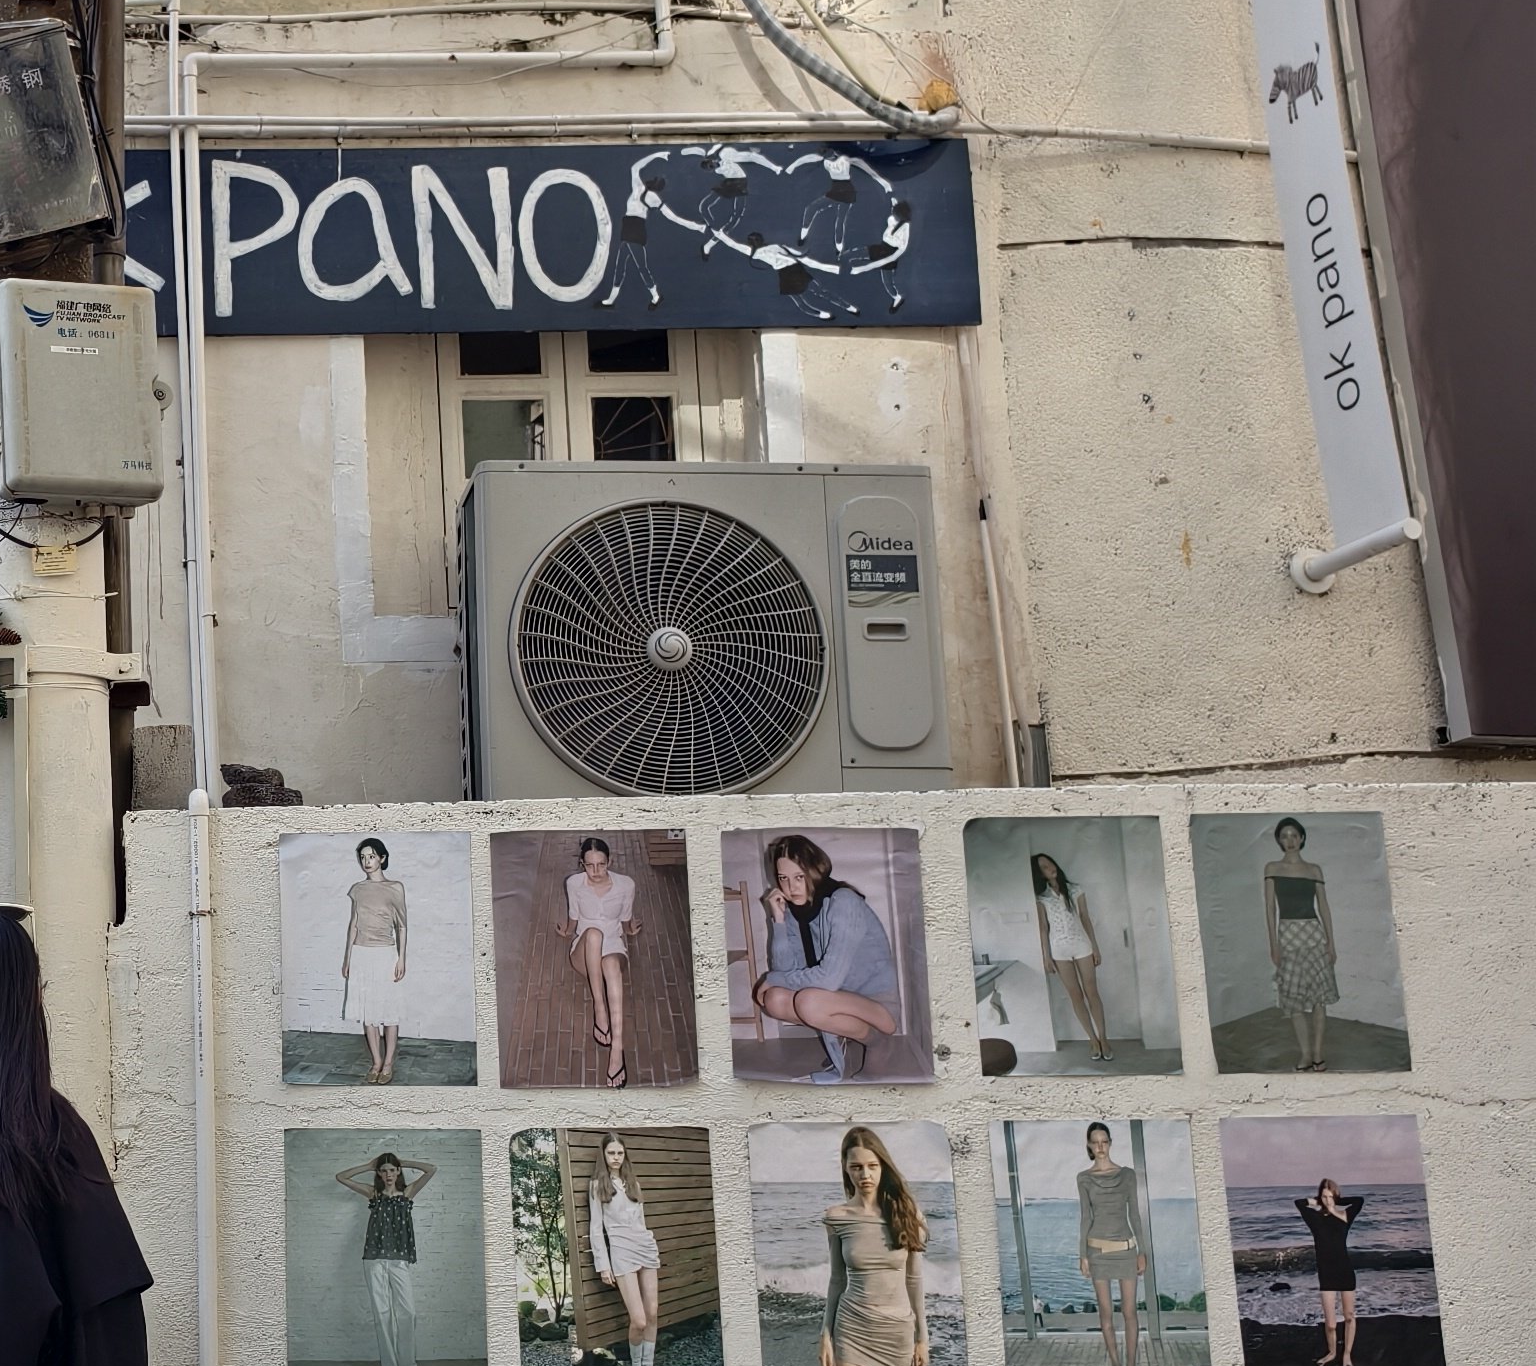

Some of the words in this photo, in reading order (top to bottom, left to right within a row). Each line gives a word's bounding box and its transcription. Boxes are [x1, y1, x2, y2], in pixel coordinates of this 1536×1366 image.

[1305, 192, 1355, 329] pano
[56, 300, 111, 314] 福建广电网络
[83, 312, 126, 320] BROADCAST
[1323, 341, 1361, 411] ok
[121, 460, 153, 471] 万马科技
[848, 530, 913, 553] Midea
[849, 559, 872, 570] 美的
[850, 571, 906, 583] 全直流变频
